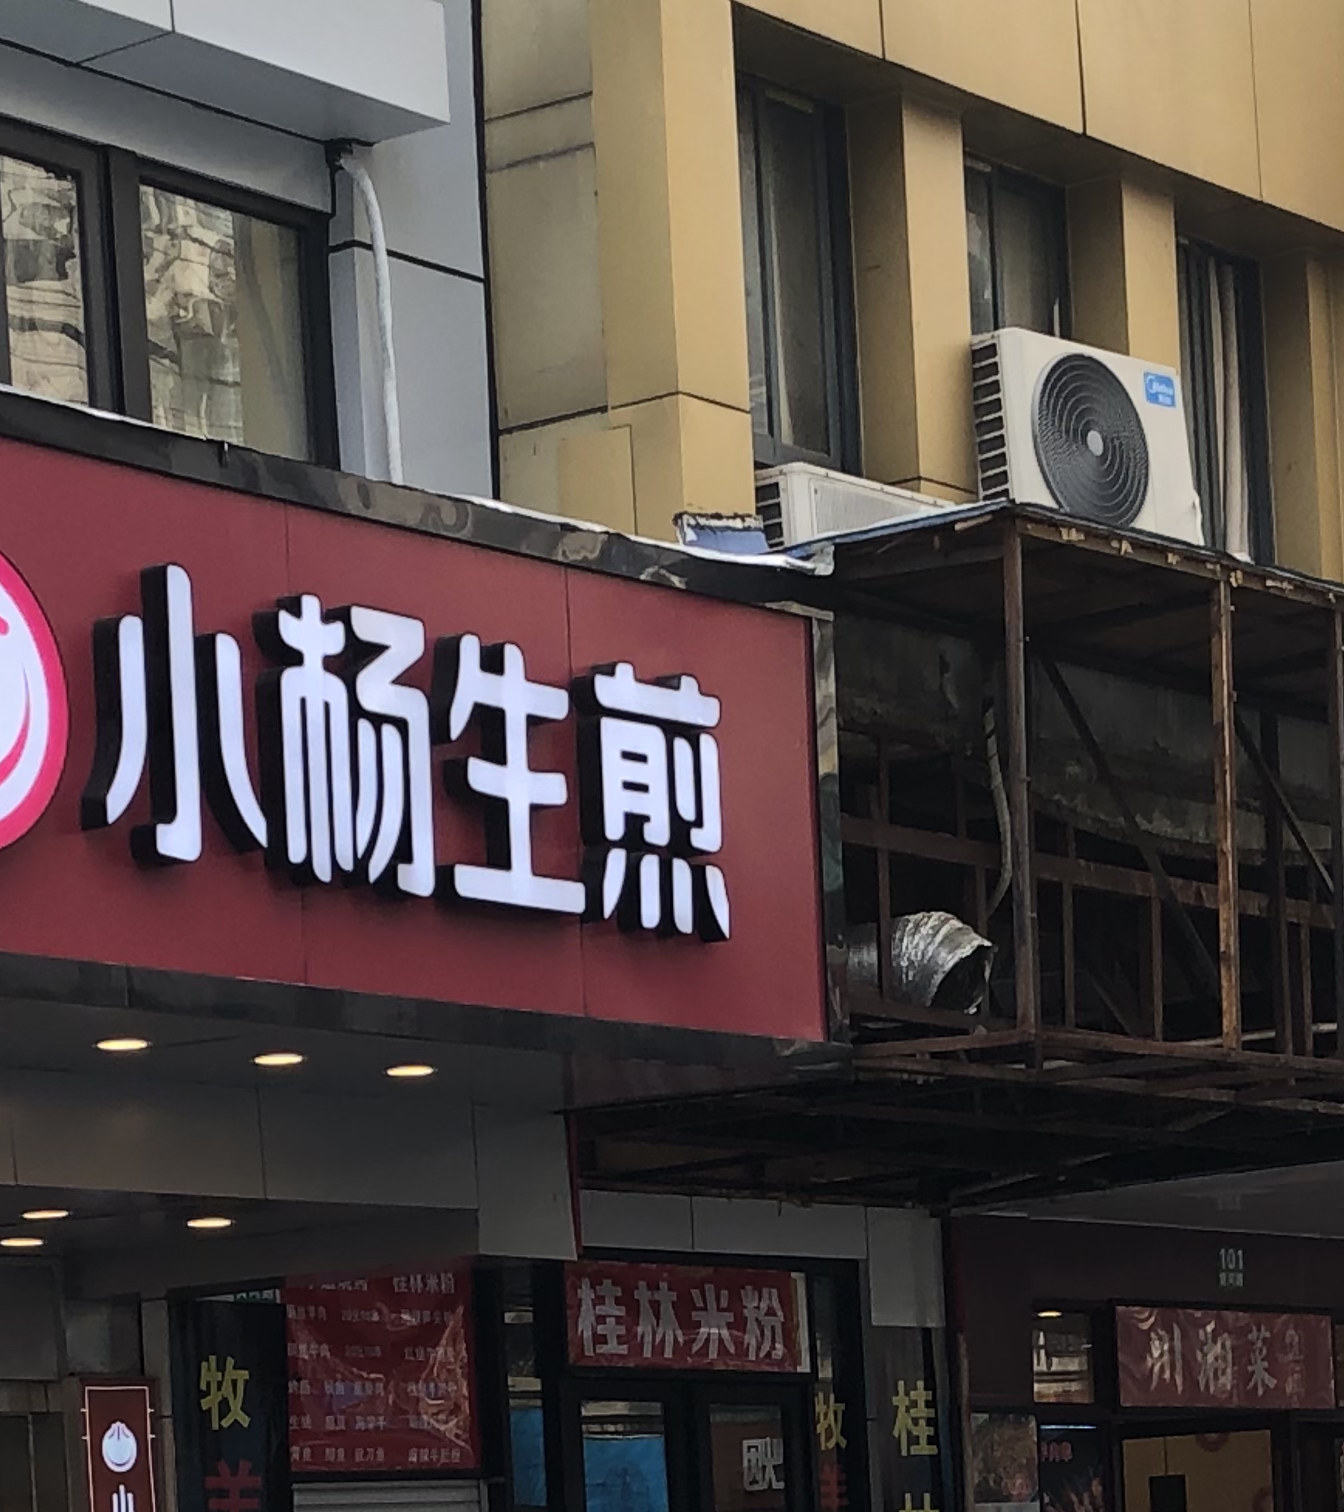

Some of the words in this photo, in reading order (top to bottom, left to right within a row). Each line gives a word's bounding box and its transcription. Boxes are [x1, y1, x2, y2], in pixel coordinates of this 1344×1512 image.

[102, 563, 731, 942] 小杨生煎
[1218, 1247, 1244, 1270] 101
[575, 1275, 789, 1364] 桂林米粉
